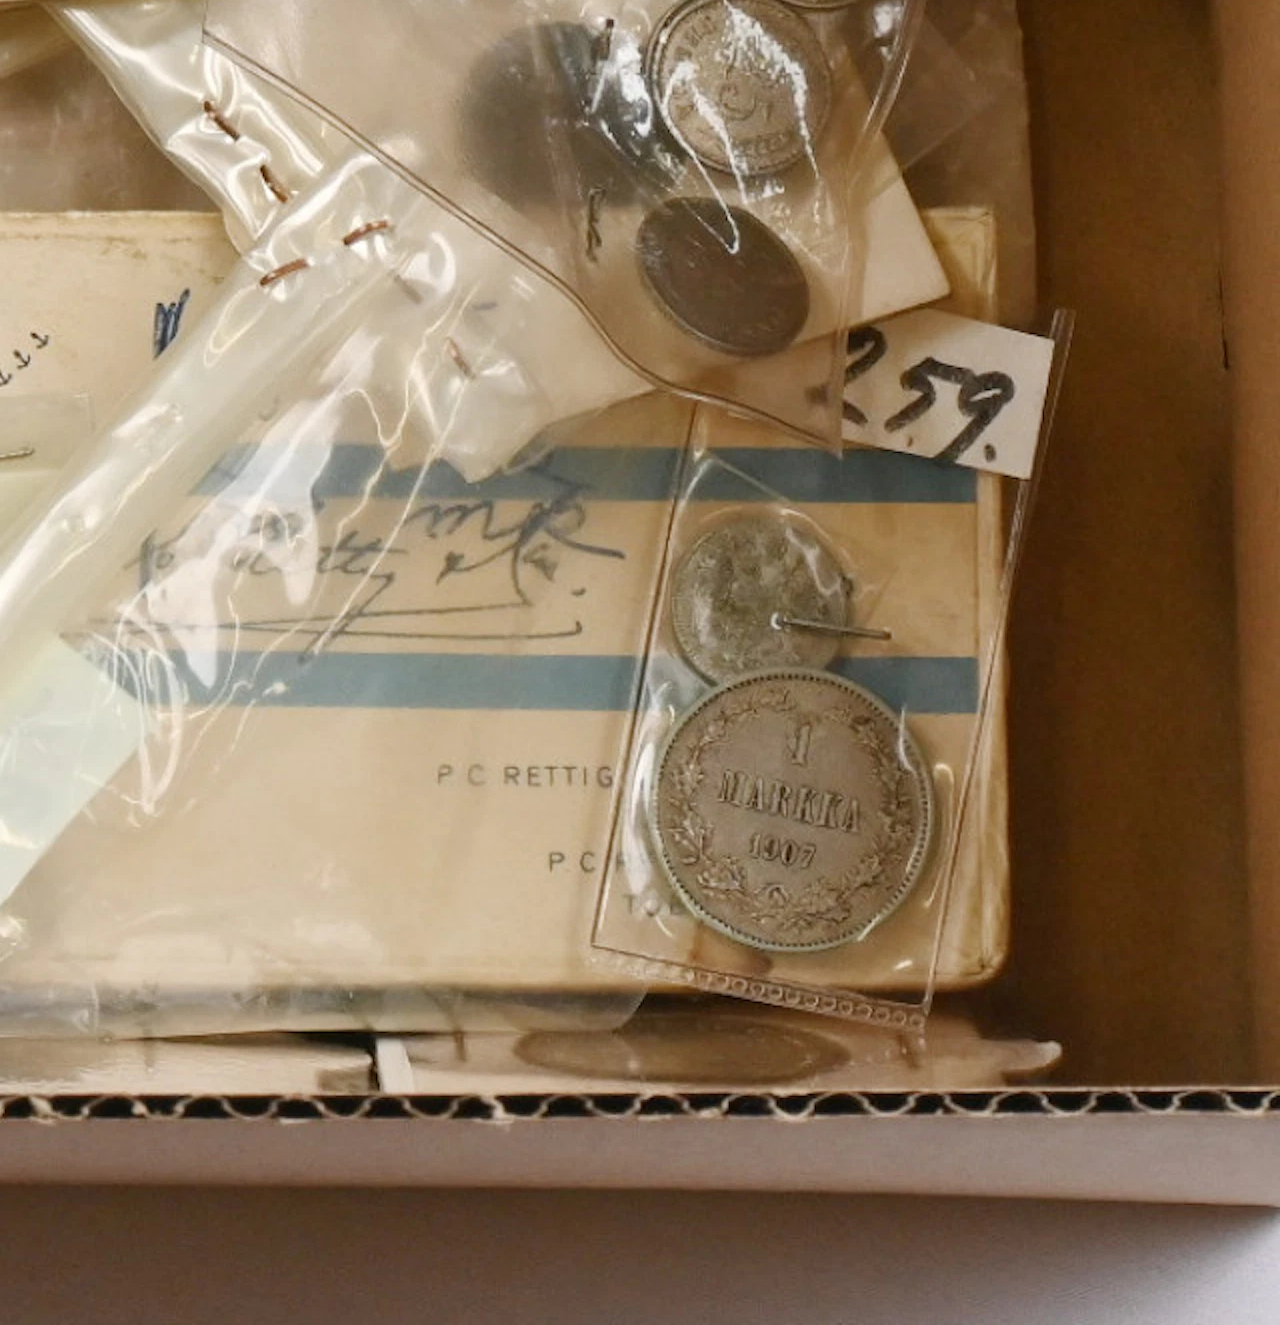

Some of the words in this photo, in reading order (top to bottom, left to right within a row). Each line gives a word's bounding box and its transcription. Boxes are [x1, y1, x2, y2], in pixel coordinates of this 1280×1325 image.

[790, 723, 812, 767] 1
[503, 765, 614, 789] RETTIG
[719, 770, 861, 834] MARKKA
[748, 833, 817, 870] 1907
